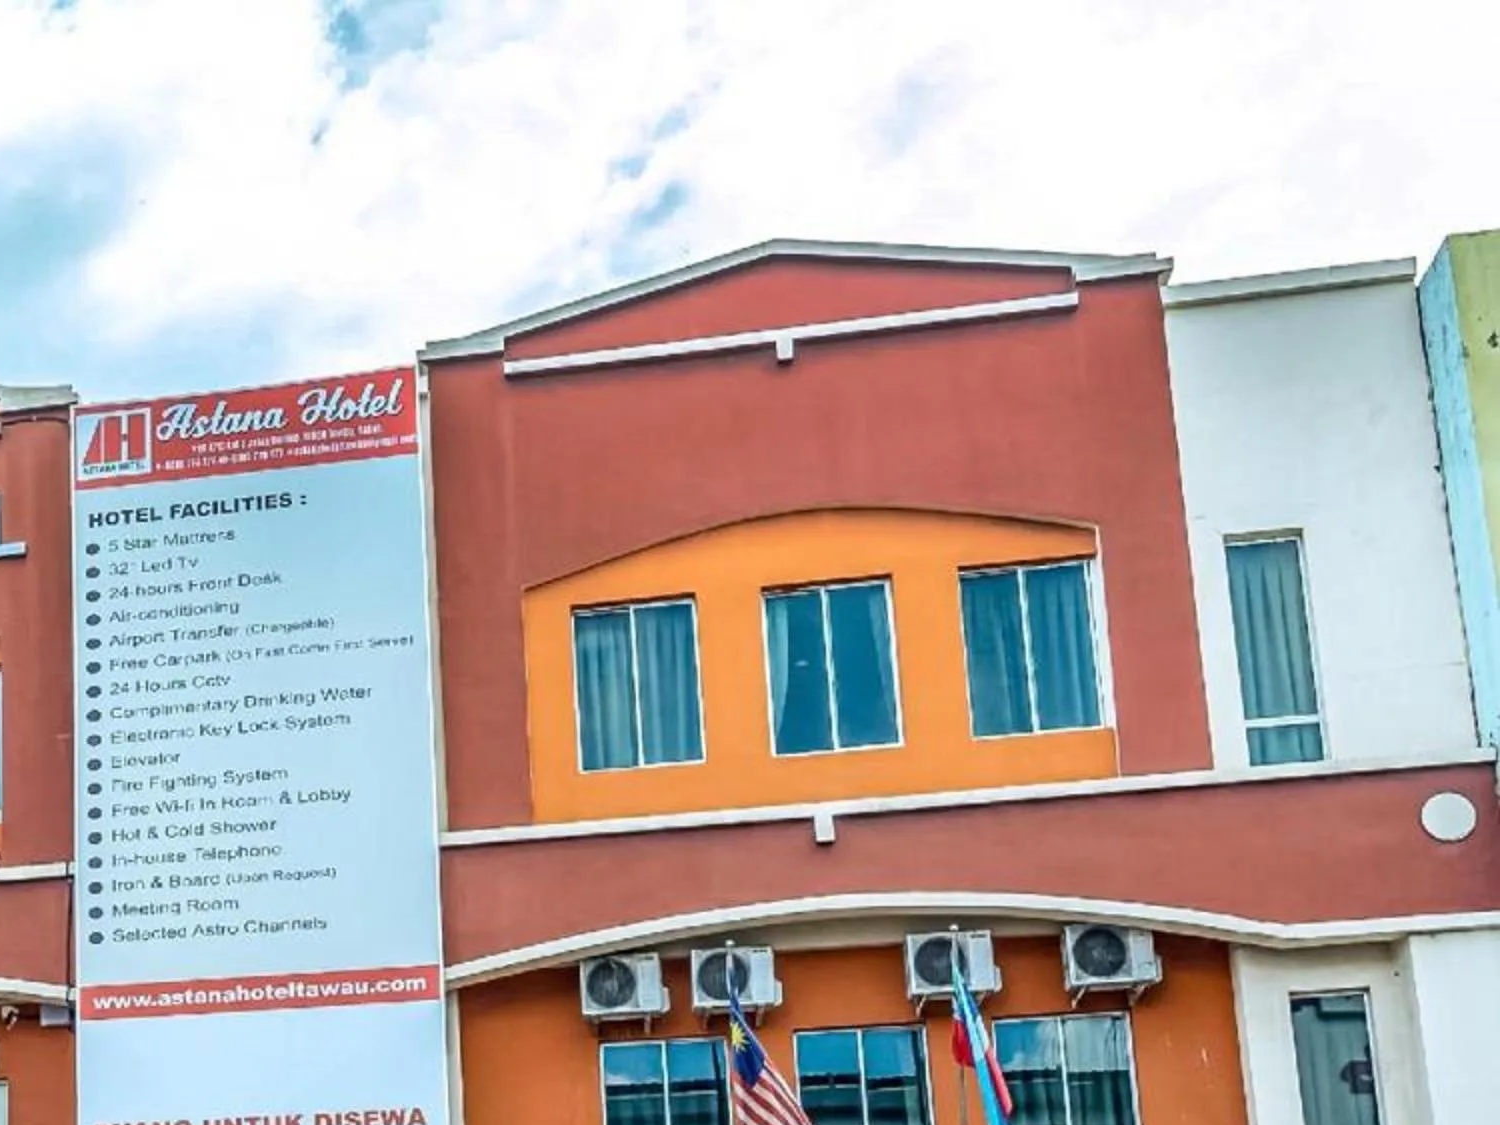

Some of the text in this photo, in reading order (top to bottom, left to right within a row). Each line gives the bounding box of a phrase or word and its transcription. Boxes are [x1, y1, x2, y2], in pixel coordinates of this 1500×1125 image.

[156, 401, 287, 442] Astana
[298, 378, 404, 426] Hotel
[88, 505, 163, 528] HOTEL
[170, 493, 293, 520] FACILITIES
[108, 540, 119, 552] 5
[124, 536, 156, 551] Star
[141, 557, 173, 574] Led
[177, 555, 200, 569] Tv
[188, 577, 234, 593] Front
[109, 601, 240, 625] Air-conditioning
[109, 631, 166, 650] Airport
[172, 624, 240, 642] Transfer
[109, 656, 149, 673] Free
[153, 651, 222, 671] Carpark
[109, 681, 131, 697] 24
[136, 675, 188, 694] Hours
[109, 685, 374, 721] Complimentary Drinking Water
[199, 722, 234, 739] Key
[238, 719, 279, 735] Lock
[284, 713, 352, 733] System
[110, 751, 182, 769] Elevator
[223, 767, 290, 787] System
[111, 802, 150, 818] Free
[279, 791, 293, 806] &
[297, 787, 352, 805] Lobby
[111, 819, 278, 843] Hot & Cold Shower
[195, 844, 283, 863] Telephone
[111, 877, 146, 893] Iron
[150, 875, 164, 890] &
[111, 897, 240, 919] Meeting Room
[111, 915, 329, 945] Selected Astro Channels
[92, 976, 428, 1011] www.astanahoteltawau.com
